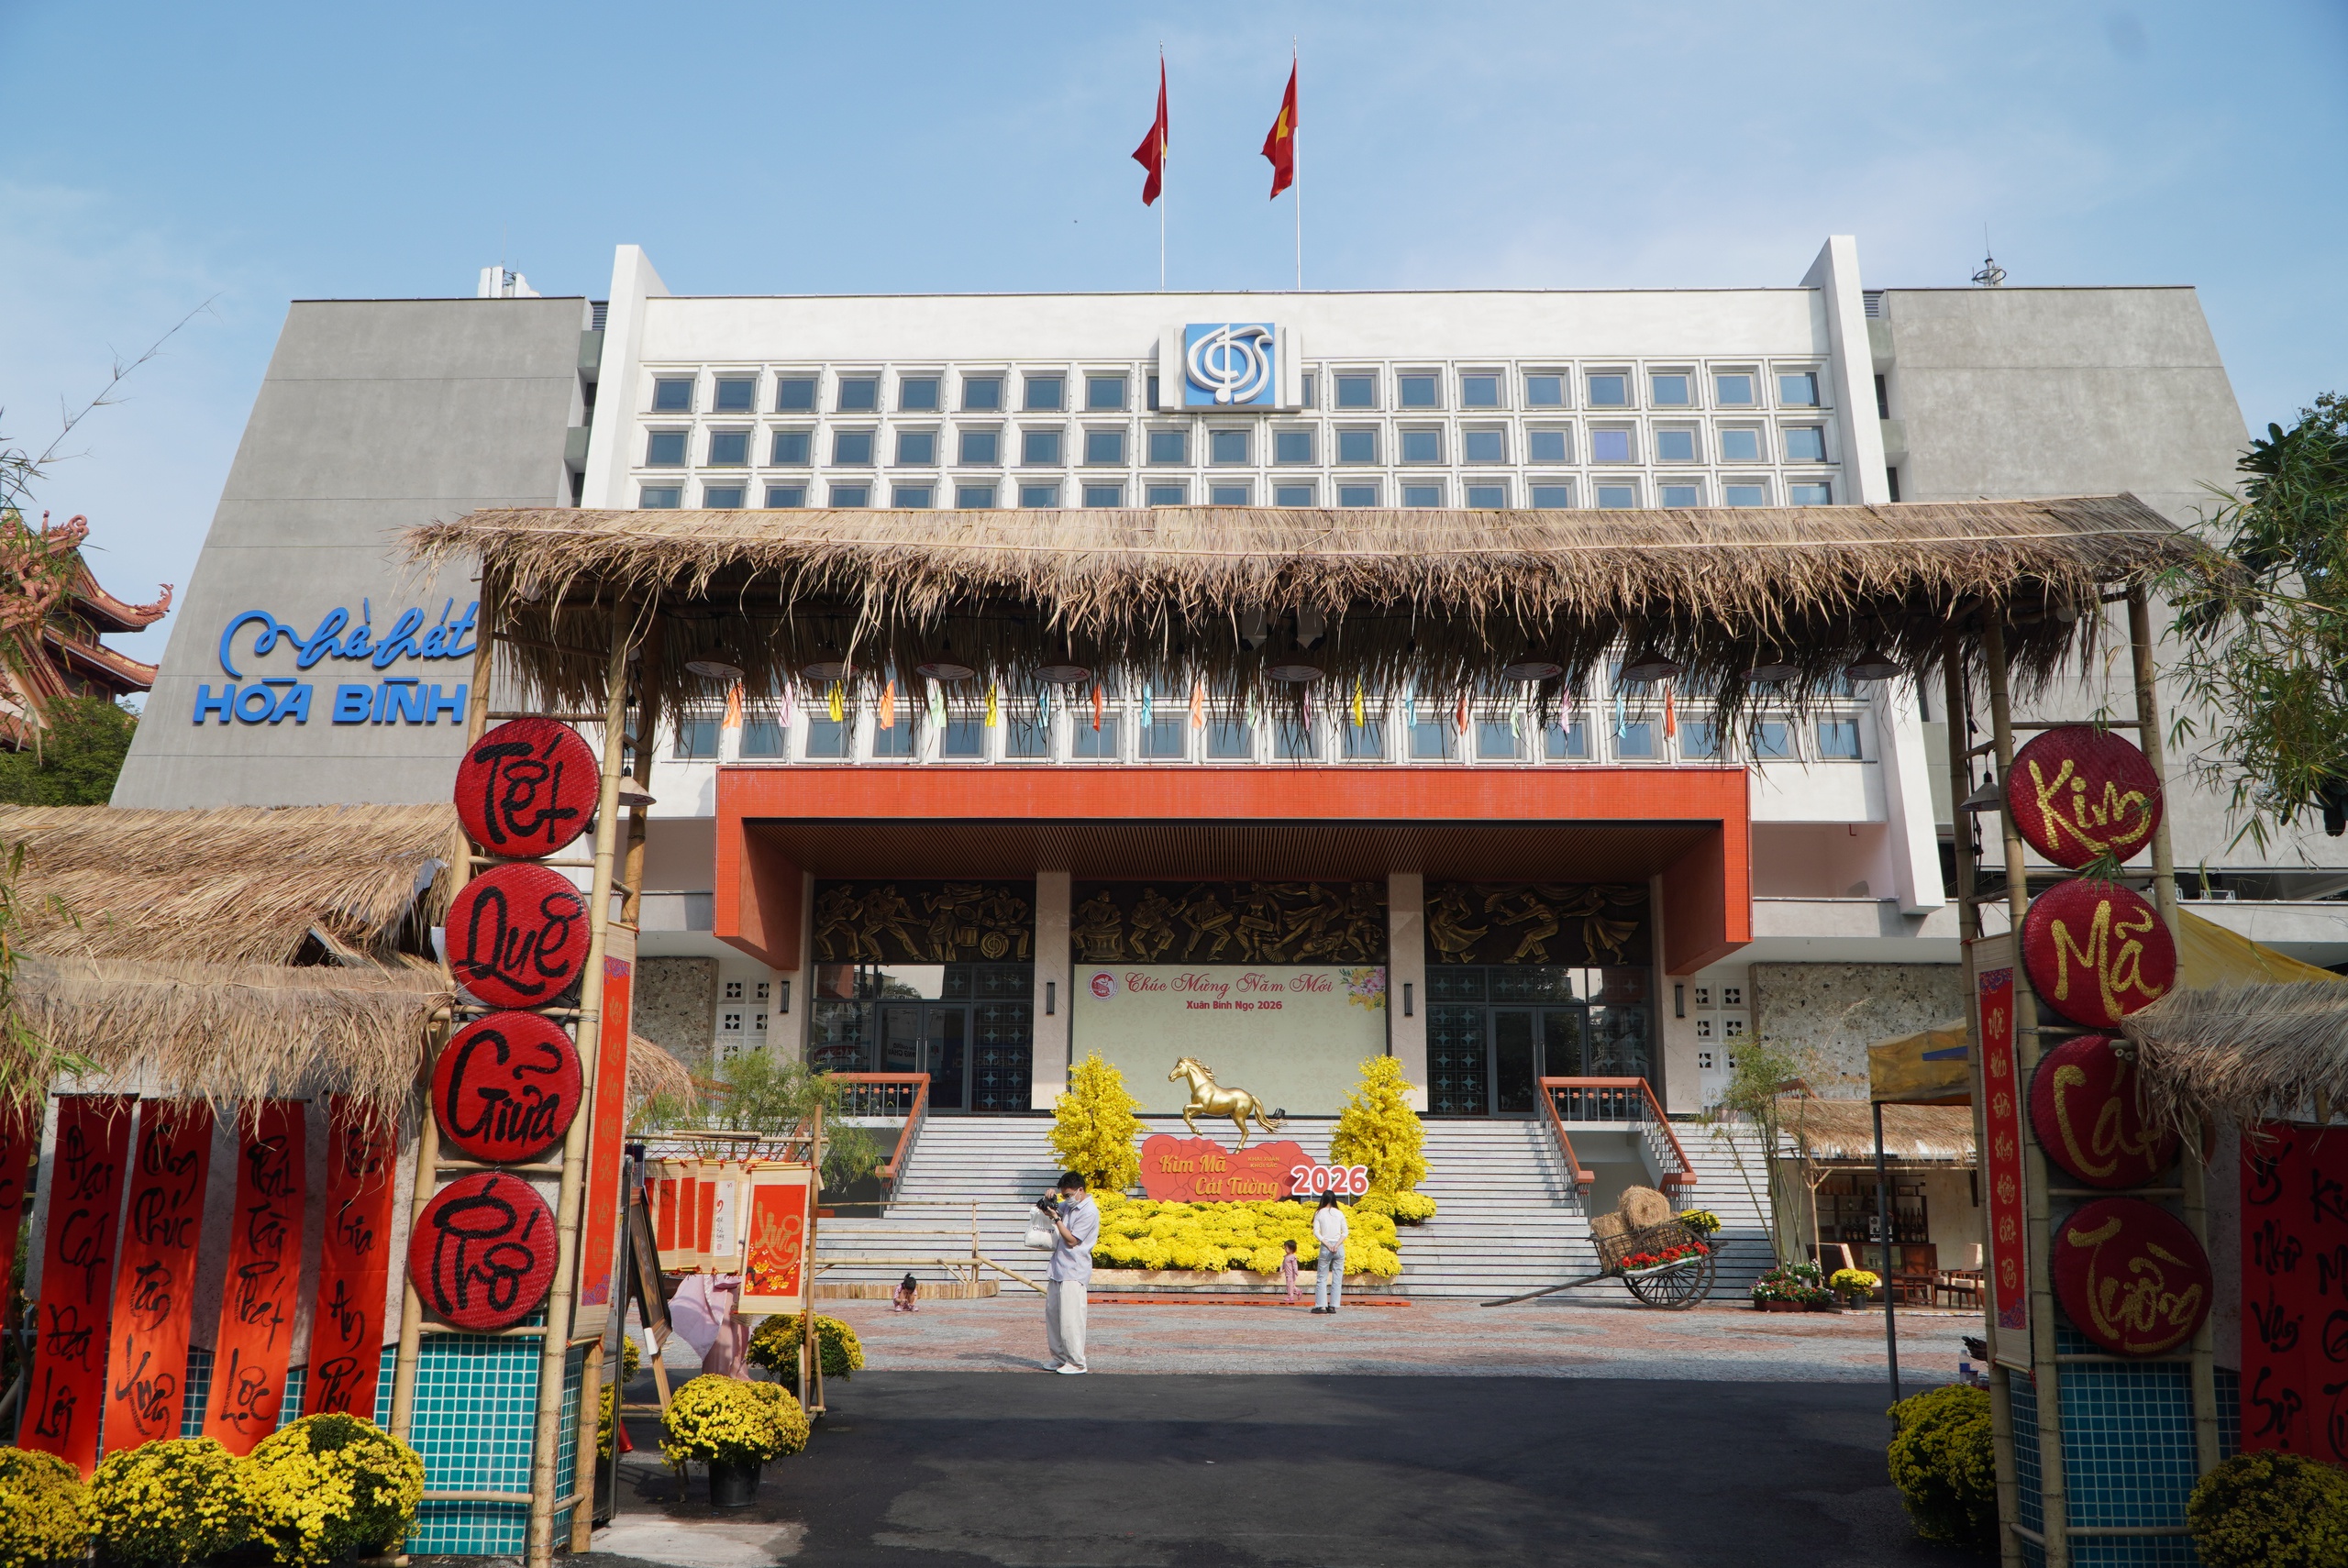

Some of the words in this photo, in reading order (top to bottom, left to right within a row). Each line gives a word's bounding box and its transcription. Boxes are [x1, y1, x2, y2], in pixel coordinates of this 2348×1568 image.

[372, 597, 480, 668] hát
[473, 734, 579, 845] Tết
[2028, 758, 2153, 856] Kim
[453, 886, 583, 997] Quê
[2050, 899, 2165, 1021] Mã
[1124, 972, 1168, 993] Chúc
[1170, 973, 1231, 1000] Mừng
[1235, 972, 1286, 993] Năm
[1289, 973, 1335, 993] Mới
[1186, 1000, 1210, 1010] Xuân
[1213, 1000, 1233, 1010] Bính
[1235, 1000, 1255, 1011] Ngọ
[1257, 1000, 1283, 1010] 2026
[448, 1028, 565, 1146] Giữa
[2053, 1056, 2167, 1178] Cát
[1158, 1154, 1194, 1174] Kim
[1198, 1154, 1228, 1174] Mã
[1194, 1176, 1224, 1196] Cát
[1226, 1176, 1279, 1200] Tường
[1290, 1165, 1370, 1197] 2026
[2309, 1167, 2348, 1225] Ki
[431, 1177, 541, 1317] Phố
[328, 1278, 366, 1353] An
[220, 1347, 272, 1435] Lộc
